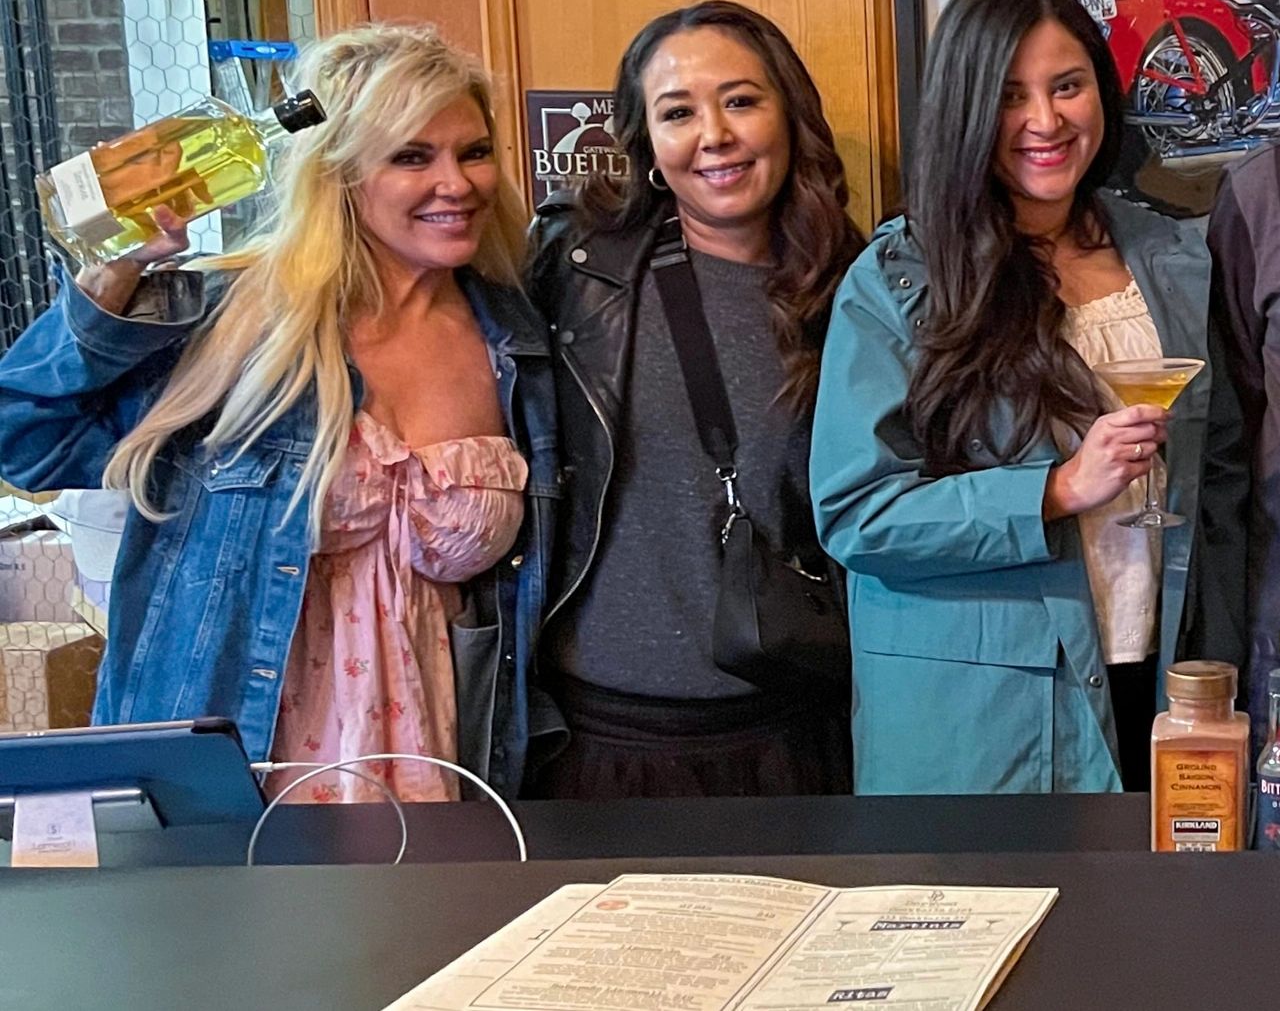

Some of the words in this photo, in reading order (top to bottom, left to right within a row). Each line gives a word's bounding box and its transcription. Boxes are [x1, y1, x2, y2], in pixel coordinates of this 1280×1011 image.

[533, 149, 631, 175] BUELLT
[1176, 763, 1217, 771] GROUND
[1178, 773, 1215, 781] SAIGON
[1170, 783, 1222, 791] CINNAMON
[1175, 821, 1218, 830] KIRKLAND
[873, 921, 961, 930] Martinis
[831, 989, 889, 1000] Ritas
